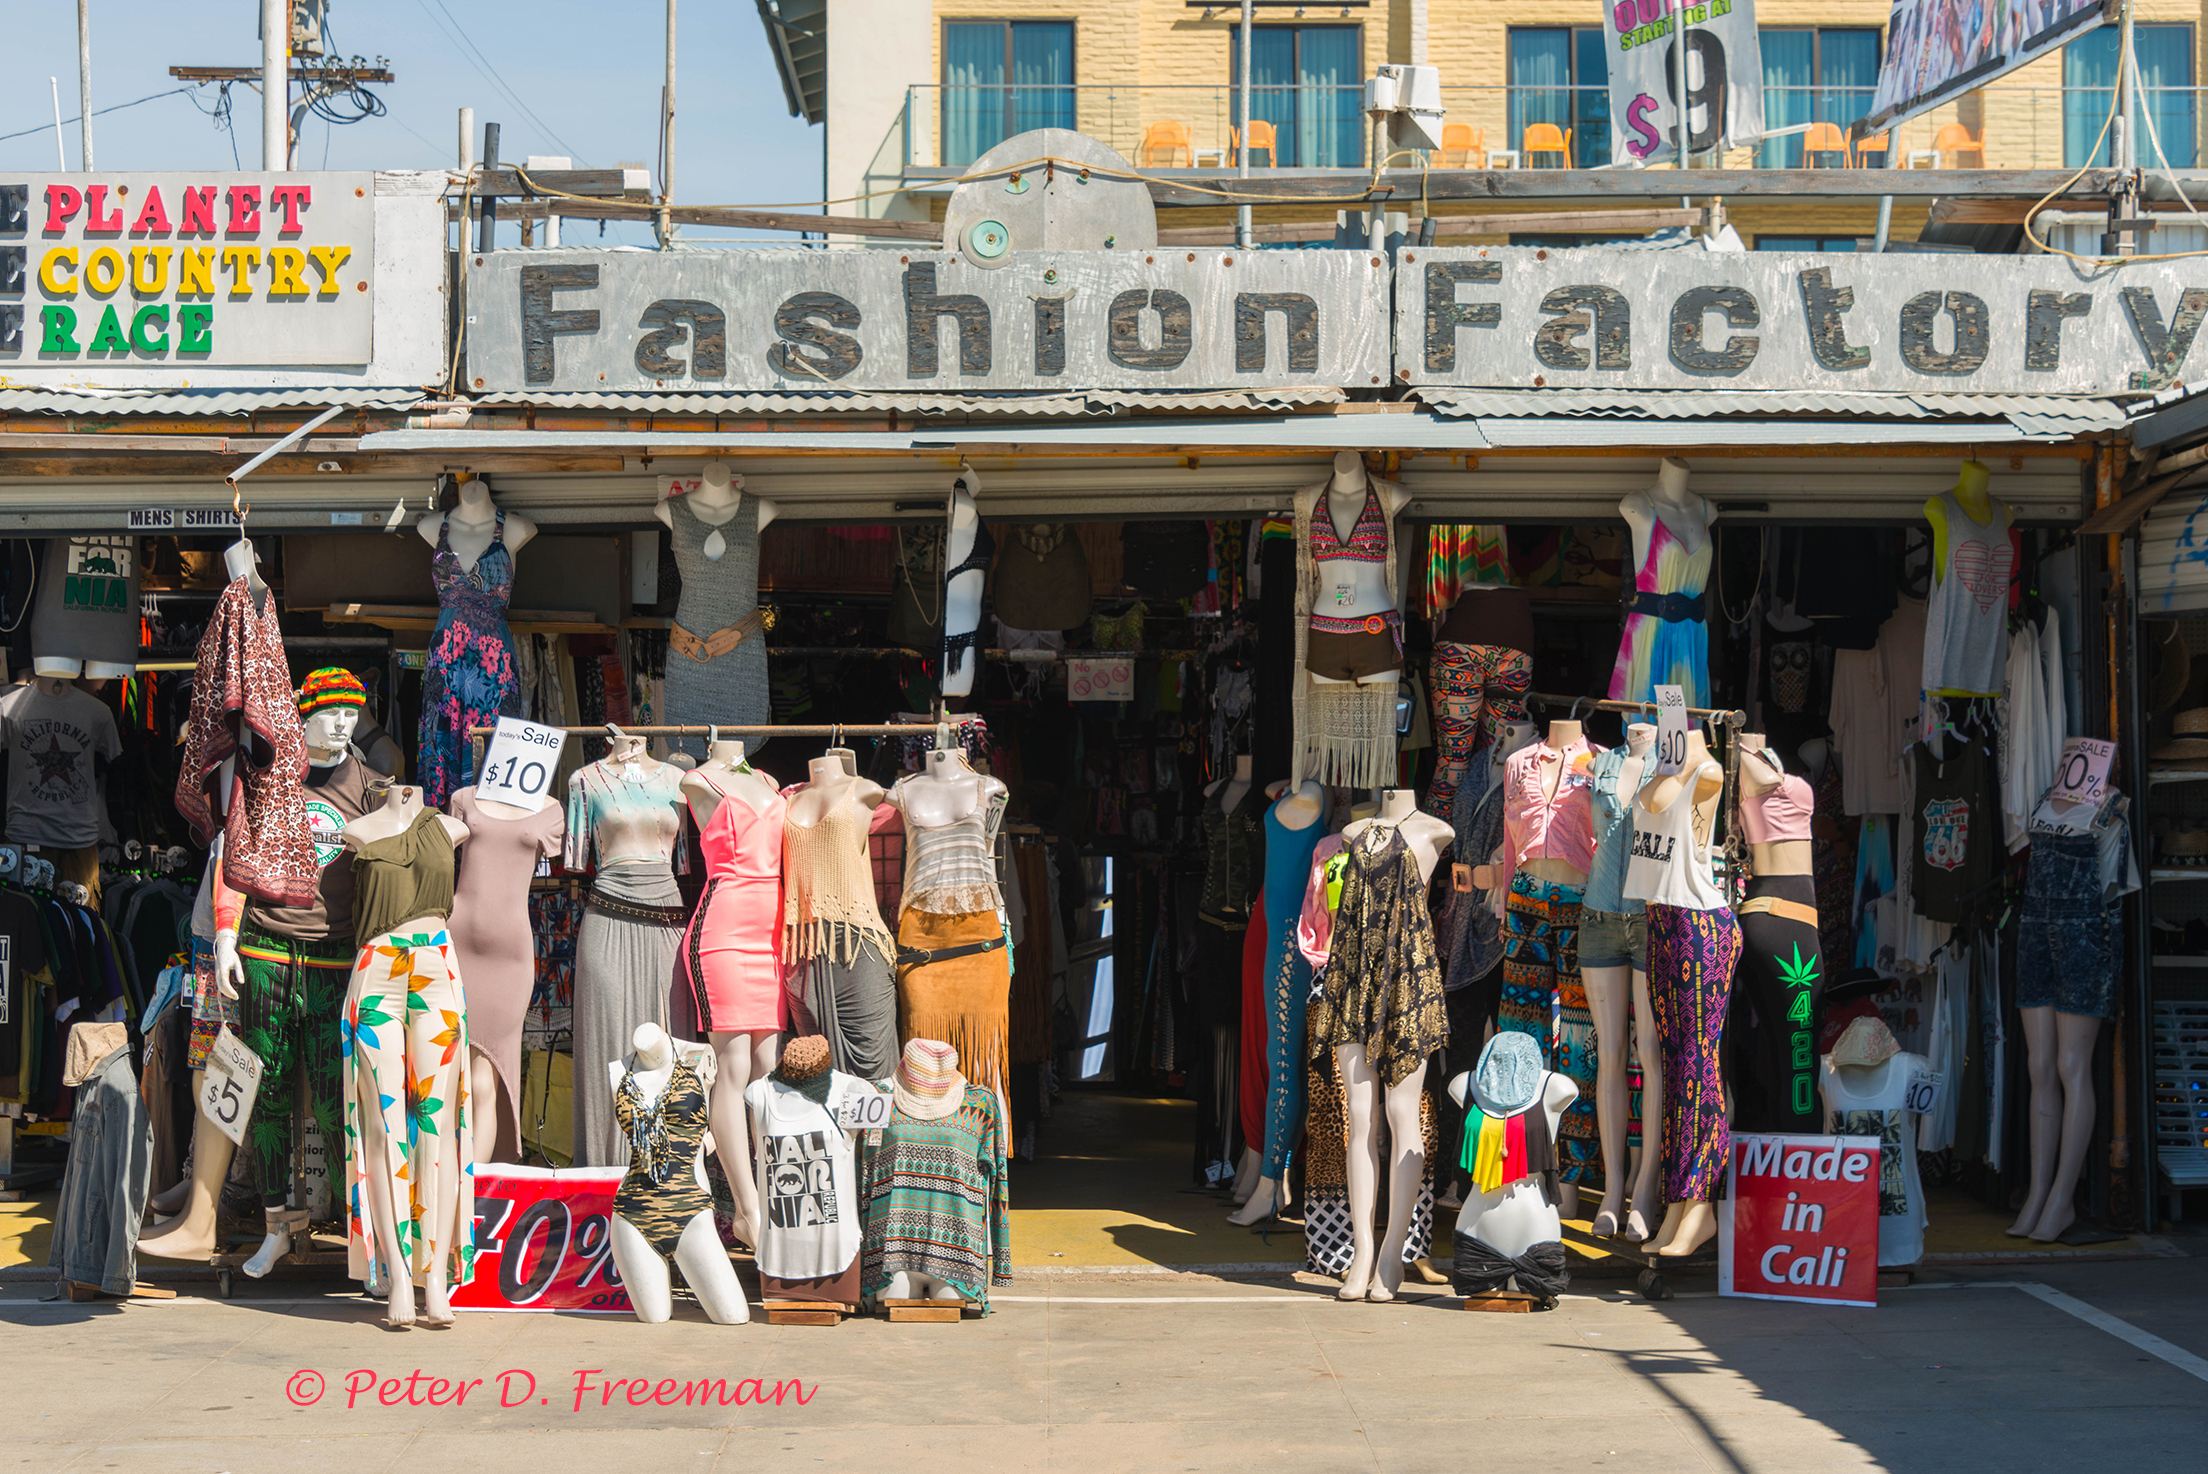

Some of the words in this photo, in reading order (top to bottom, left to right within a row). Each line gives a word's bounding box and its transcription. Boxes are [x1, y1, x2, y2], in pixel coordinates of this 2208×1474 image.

[1620, 5, 1707, 51] STARTNG
[44, 184, 312, 236] PLANET
[39, 246, 351, 298] COUNTRY
[40, 304, 214, 355] RACE
[520, 260, 1319, 384] Fashion
[1424, 260, 2208, 391] Factory
[130, 510, 172, 526] MENS
[185, 510, 242, 525] SHIRTS
[65, 576, 127, 607] NIA
[405, 654, 426, 666] ONE
[1074, 663, 1091, 673] No
[1665, 691, 1683, 707] Sale
[20, 722, 91, 751] CALIFORNIA
[521, 727, 560, 749] Sale
[1660, 730, 1686, 766] $10
[2080, 741, 2109, 758] SALE
[485, 756, 546, 794] $10
[31, 783, 80, 802] REPUBLIC
[1631, 829, 1676, 863] CALI
[231, 1047, 255, 1079] Sale
[1786, 990, 1814, 1116] 420
[208, 1077, 243, 1123] $5
[849, 1096, 885, 1124] $10
[1906, 1082, 1934, 1111] $10
[1739, 1136, 1872, 1183] Made
[498, 1179, 517, 1192] to
[822, 1191, 839, 1225] REPUBLIC
[1781, 1191, 1825, 1233] in
[1760, 1244, 1849, 1287] Cali
[591, 1290, 630, 1306] off
